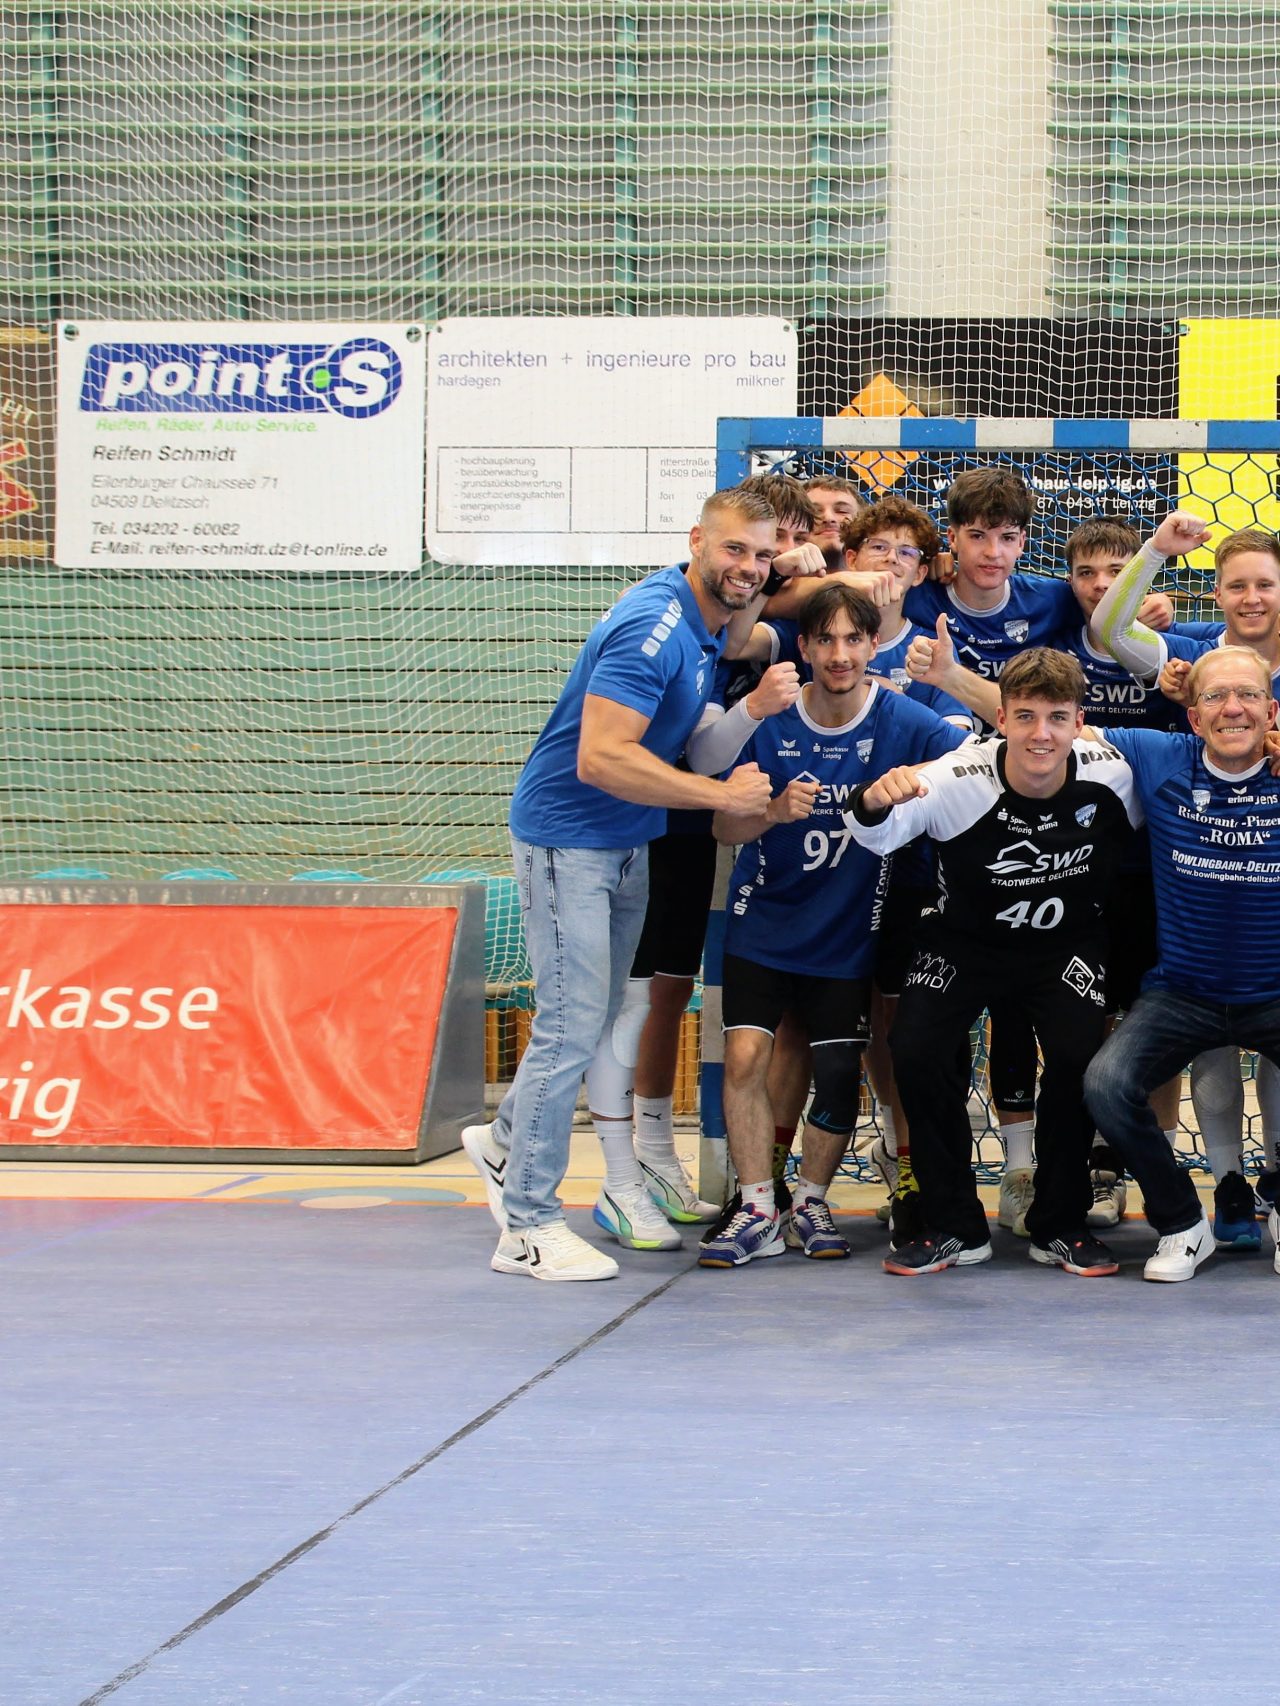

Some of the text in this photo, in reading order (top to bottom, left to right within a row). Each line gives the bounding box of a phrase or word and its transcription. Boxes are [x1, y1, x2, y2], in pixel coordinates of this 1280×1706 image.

[437, 350, 548, 368] architekten
[586, 350, 691, 372] ingenieure
[704, 353, 736, 372] pro
[749, 350, 787, 368] bau
[100, 351, 292, 407] point
[437, 373, 785, 390] hardegen milkner
[95, 417, 151, 433] Reifen,
[92, 445, 237, 461] Reifen Schmidt
[691, 469, 717, 478] Delitz
[181, 475, 257, 490] Chaussee
[1113, 497, 1156, 511] Leipzig
[659, 514, 674, 523] fax
[91, 521, 117, 536] Tel.
[90, 541, 144, 556] E-Mail:
[1090, 683, 1146, 704] SWD
[1108, 707, 1147, 715] DELITZSCH
[1227, 795, 1254, 804] erima
[1007, 824, 1033, 836] Leipzig
[1037, 820, 1059, 832] erima
[802, 829, 853, 871] 97
[1031, 844, 1094, 873] SWD
[990, 864, 1091, 887] STADTWERKE DELITZSCH
[870, 898, 884, 931] NHV
[995, 896, 1065, 930] 40
